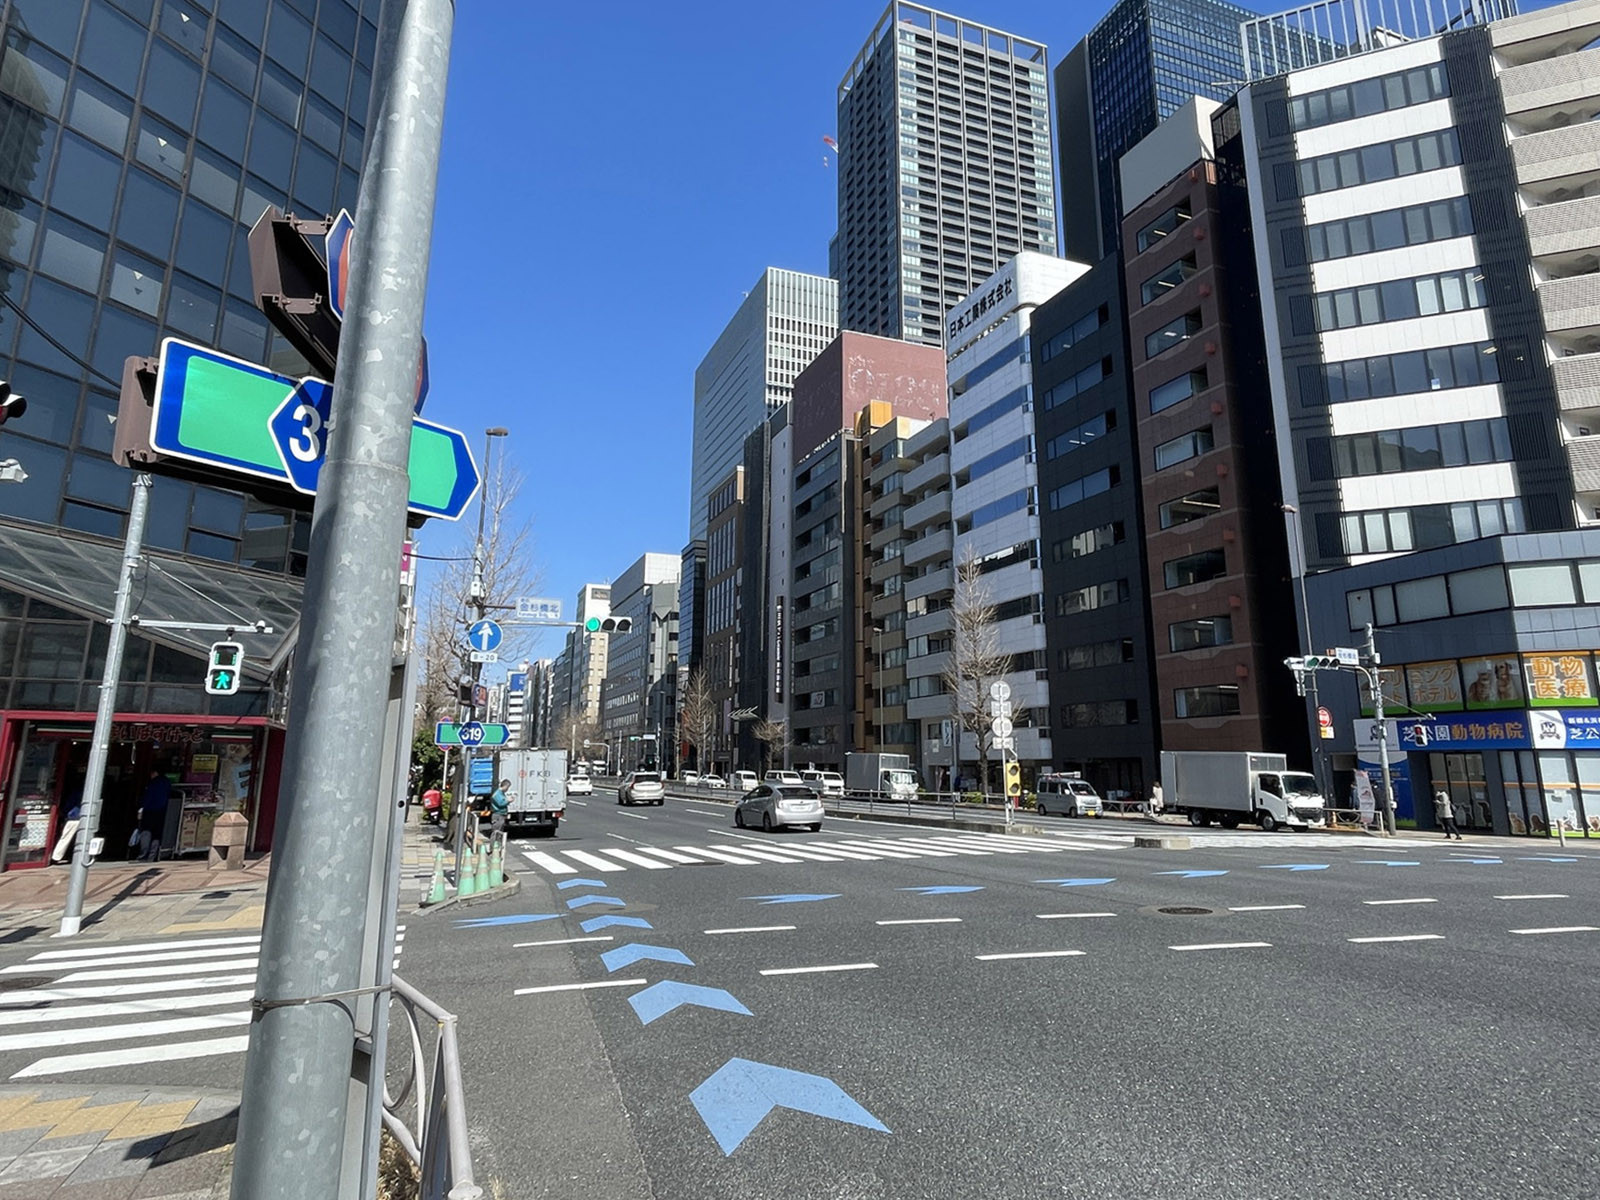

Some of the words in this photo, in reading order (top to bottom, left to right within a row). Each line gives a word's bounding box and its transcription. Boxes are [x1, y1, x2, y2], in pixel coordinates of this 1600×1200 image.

[1531, 657, 1584, 677] 動物
[1535, 678, 1588, 698] 医療
[461, 728, 482, 741] 319
